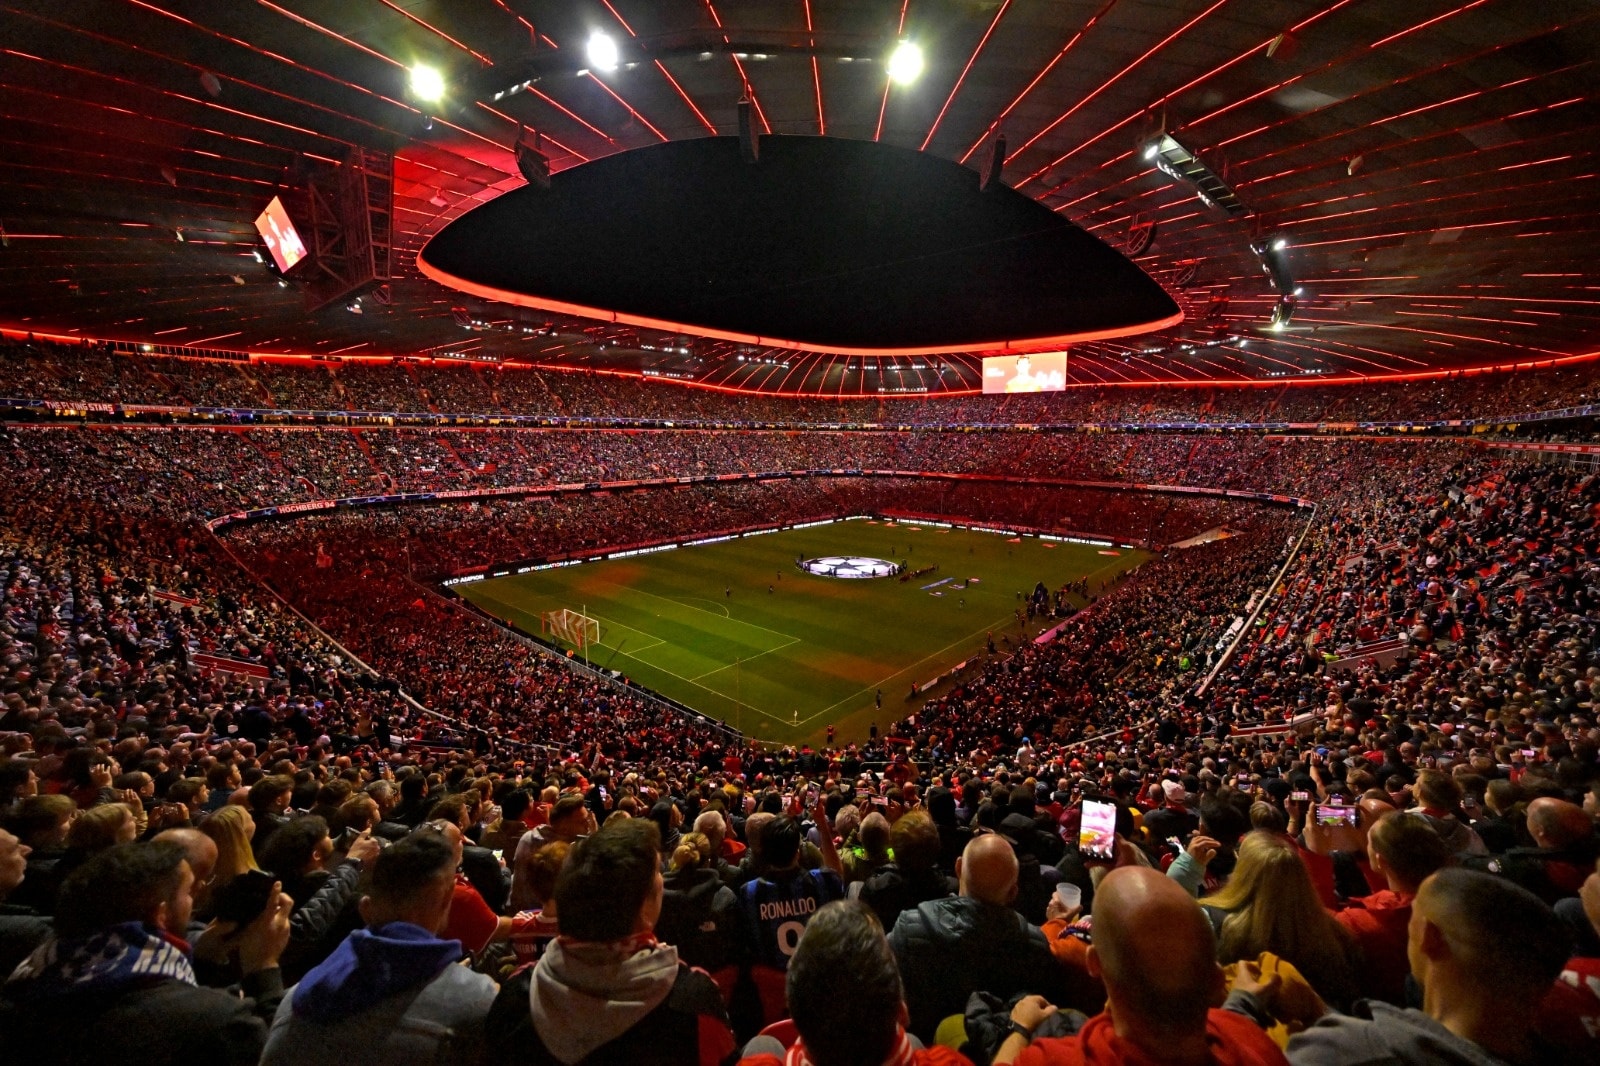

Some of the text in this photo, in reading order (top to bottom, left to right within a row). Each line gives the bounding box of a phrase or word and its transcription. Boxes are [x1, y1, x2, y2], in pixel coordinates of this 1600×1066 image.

[44, 400, 62, 410] THE
[62, 401, 88, 411] FLYING
[88, 403, 114, 412] STARS
[279, 500, 336, 514] HOCHBERG 94
[759, 896, 817, 920] RONALDO
